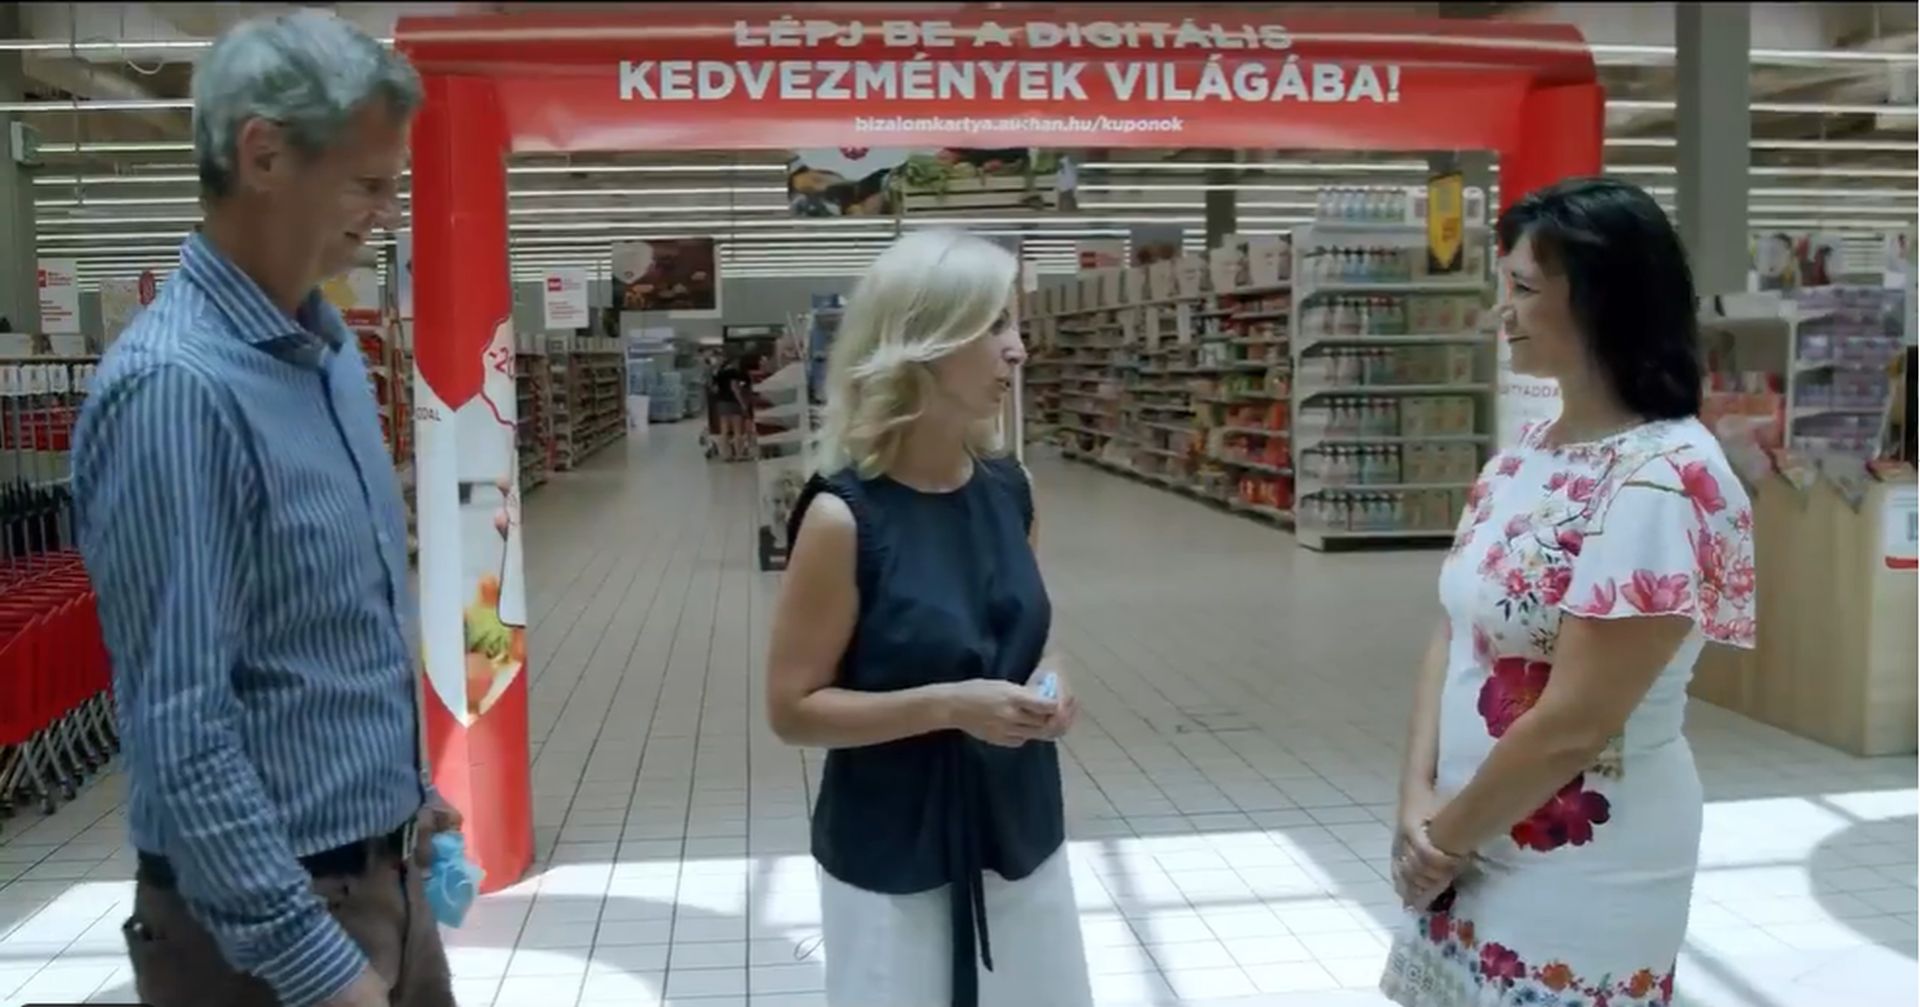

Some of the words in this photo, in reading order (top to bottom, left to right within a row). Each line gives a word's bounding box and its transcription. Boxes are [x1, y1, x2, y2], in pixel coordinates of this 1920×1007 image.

[734, 14, 864, 46] LÉPJ
[882, 21, 955, 46] BE
[972, 21, 1013, 46] A
[1025, 18, 1293, 49] DIGITÁLIS
[618, 52, 1089, 100] KEDVEZMÉNYEK
[1104, 54, 1401, 102] VILÁGÁBA!
